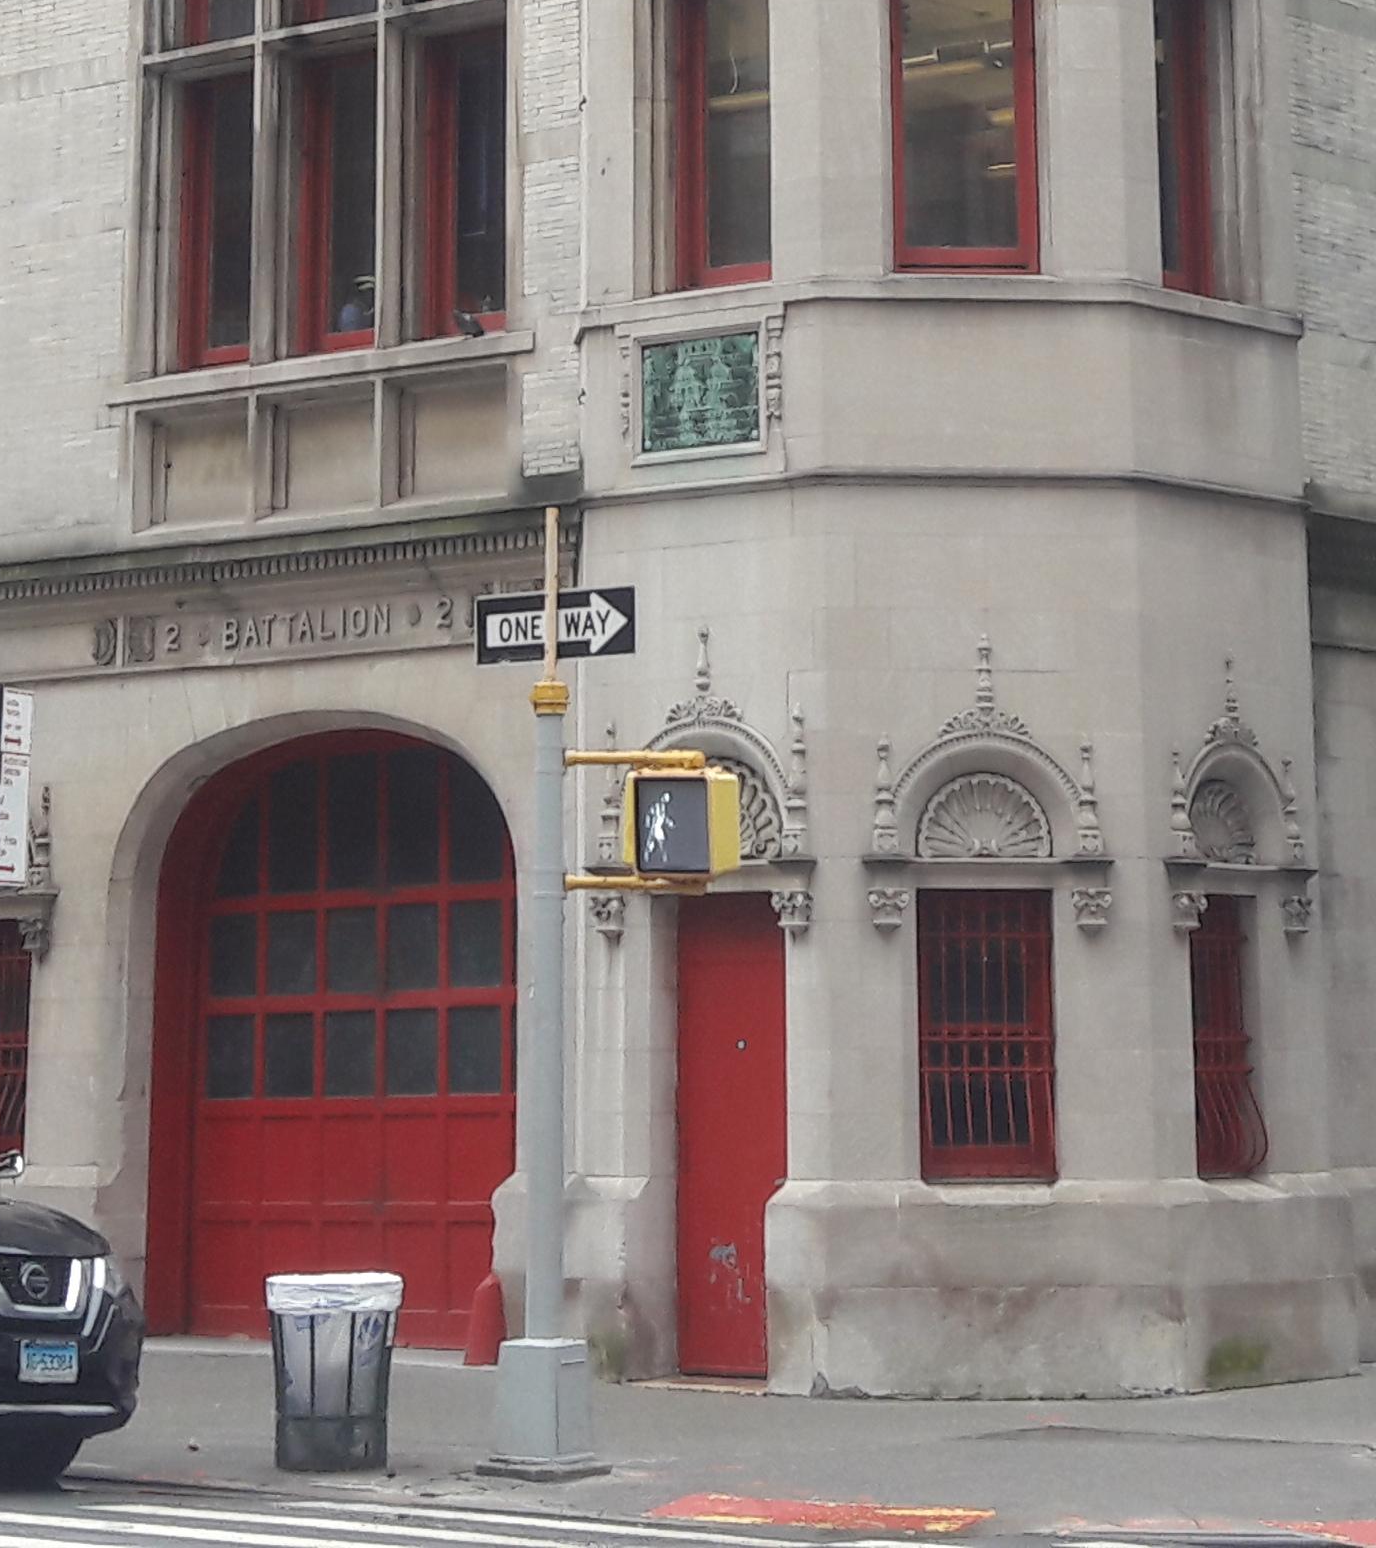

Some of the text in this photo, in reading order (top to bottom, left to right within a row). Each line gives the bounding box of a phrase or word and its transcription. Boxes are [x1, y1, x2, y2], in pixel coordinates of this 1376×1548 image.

[164, 598, 454, 652] 2 BATTALION 2
[499, 609, 610, 643] ONE WAY
